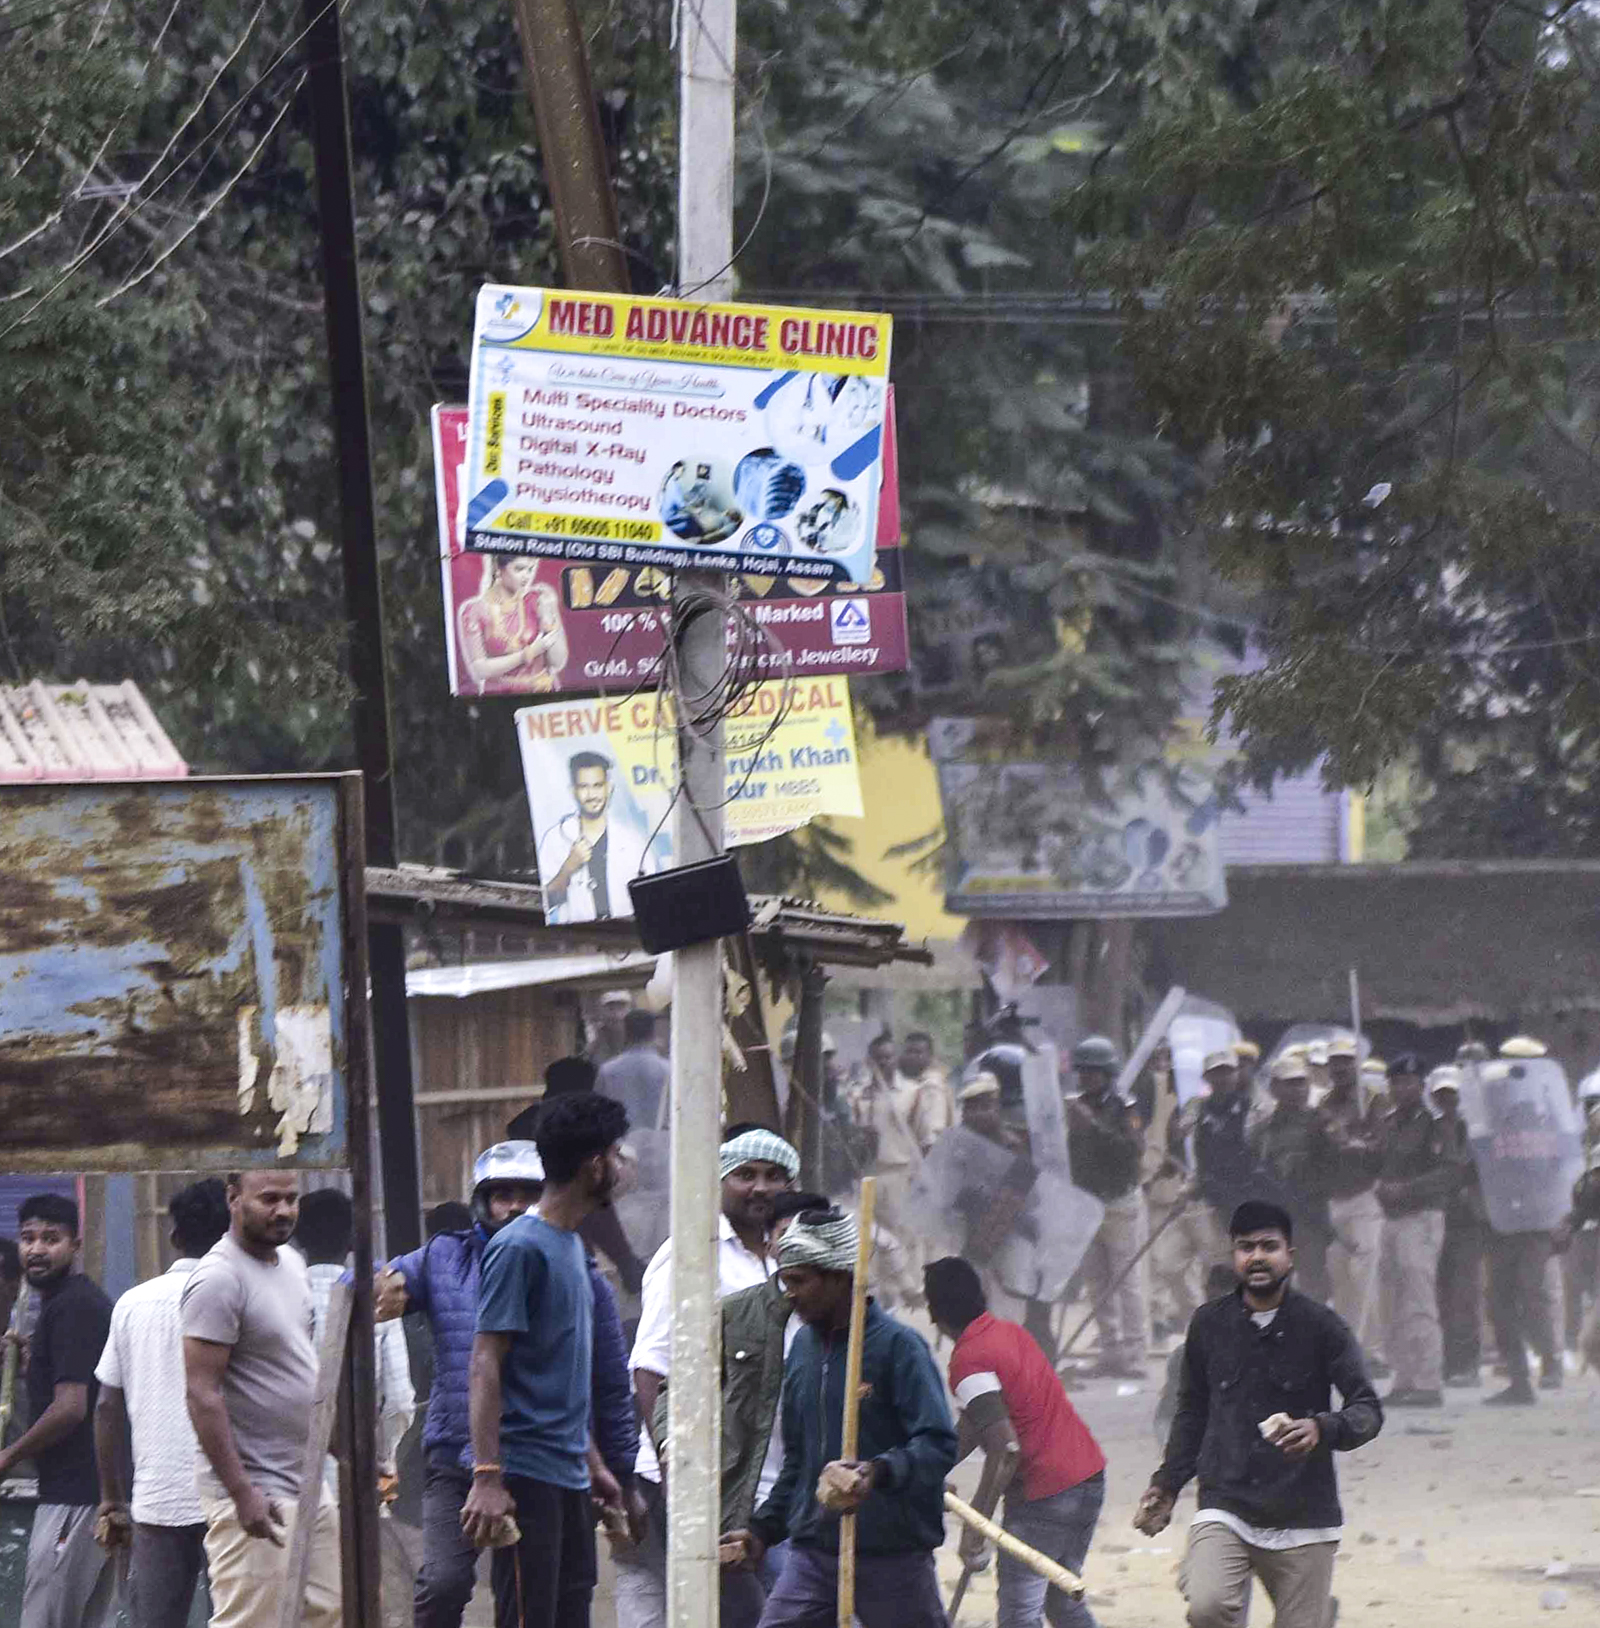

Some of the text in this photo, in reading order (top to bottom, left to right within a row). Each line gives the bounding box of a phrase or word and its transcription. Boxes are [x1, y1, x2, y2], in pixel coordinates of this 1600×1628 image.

[548, 300, 878, 360] MED ADVANCE CLINIC
[523, 388, 747, 422] Multi Speciality Doctors
[521, 412, 623, 435] Ultrasound
[520, 436, 647, 464] Digital X-Ray
[518, 460, 615, 484] Pathology
[474, 535, 524, 552] Station
[526, 539, 562, 556] Road
[565, 541, 596, 559] (Old
[597, 544, 623, 561] SBI
[785, 559, 834, 577] Assam
[755, 602, 825, 624] Marked
[796, 645, 880, 666] Jewellery
[526, 704, 623, 740] NERVE
[728, 682, 843, 720] EDICAL
[727, 753, 783, 776] rukh
[791, 746, 850, 769] Khan
